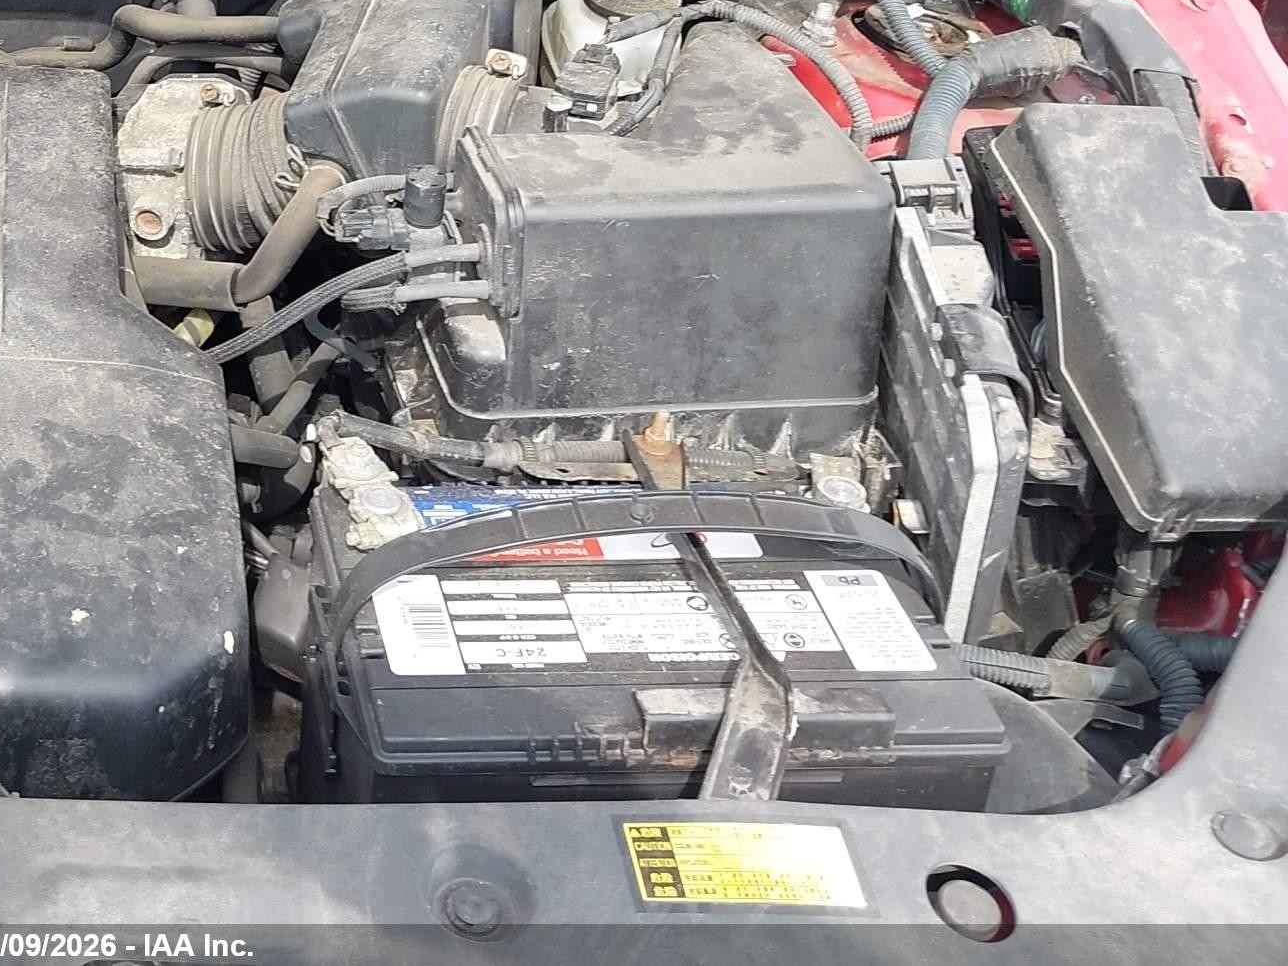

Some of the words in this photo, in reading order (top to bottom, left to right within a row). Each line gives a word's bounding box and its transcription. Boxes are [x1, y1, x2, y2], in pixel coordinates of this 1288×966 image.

[554, 547, 589, 556] Need
[838, 576, 861, 586] Pb
[495, 647, 547, 657] 24F-C
